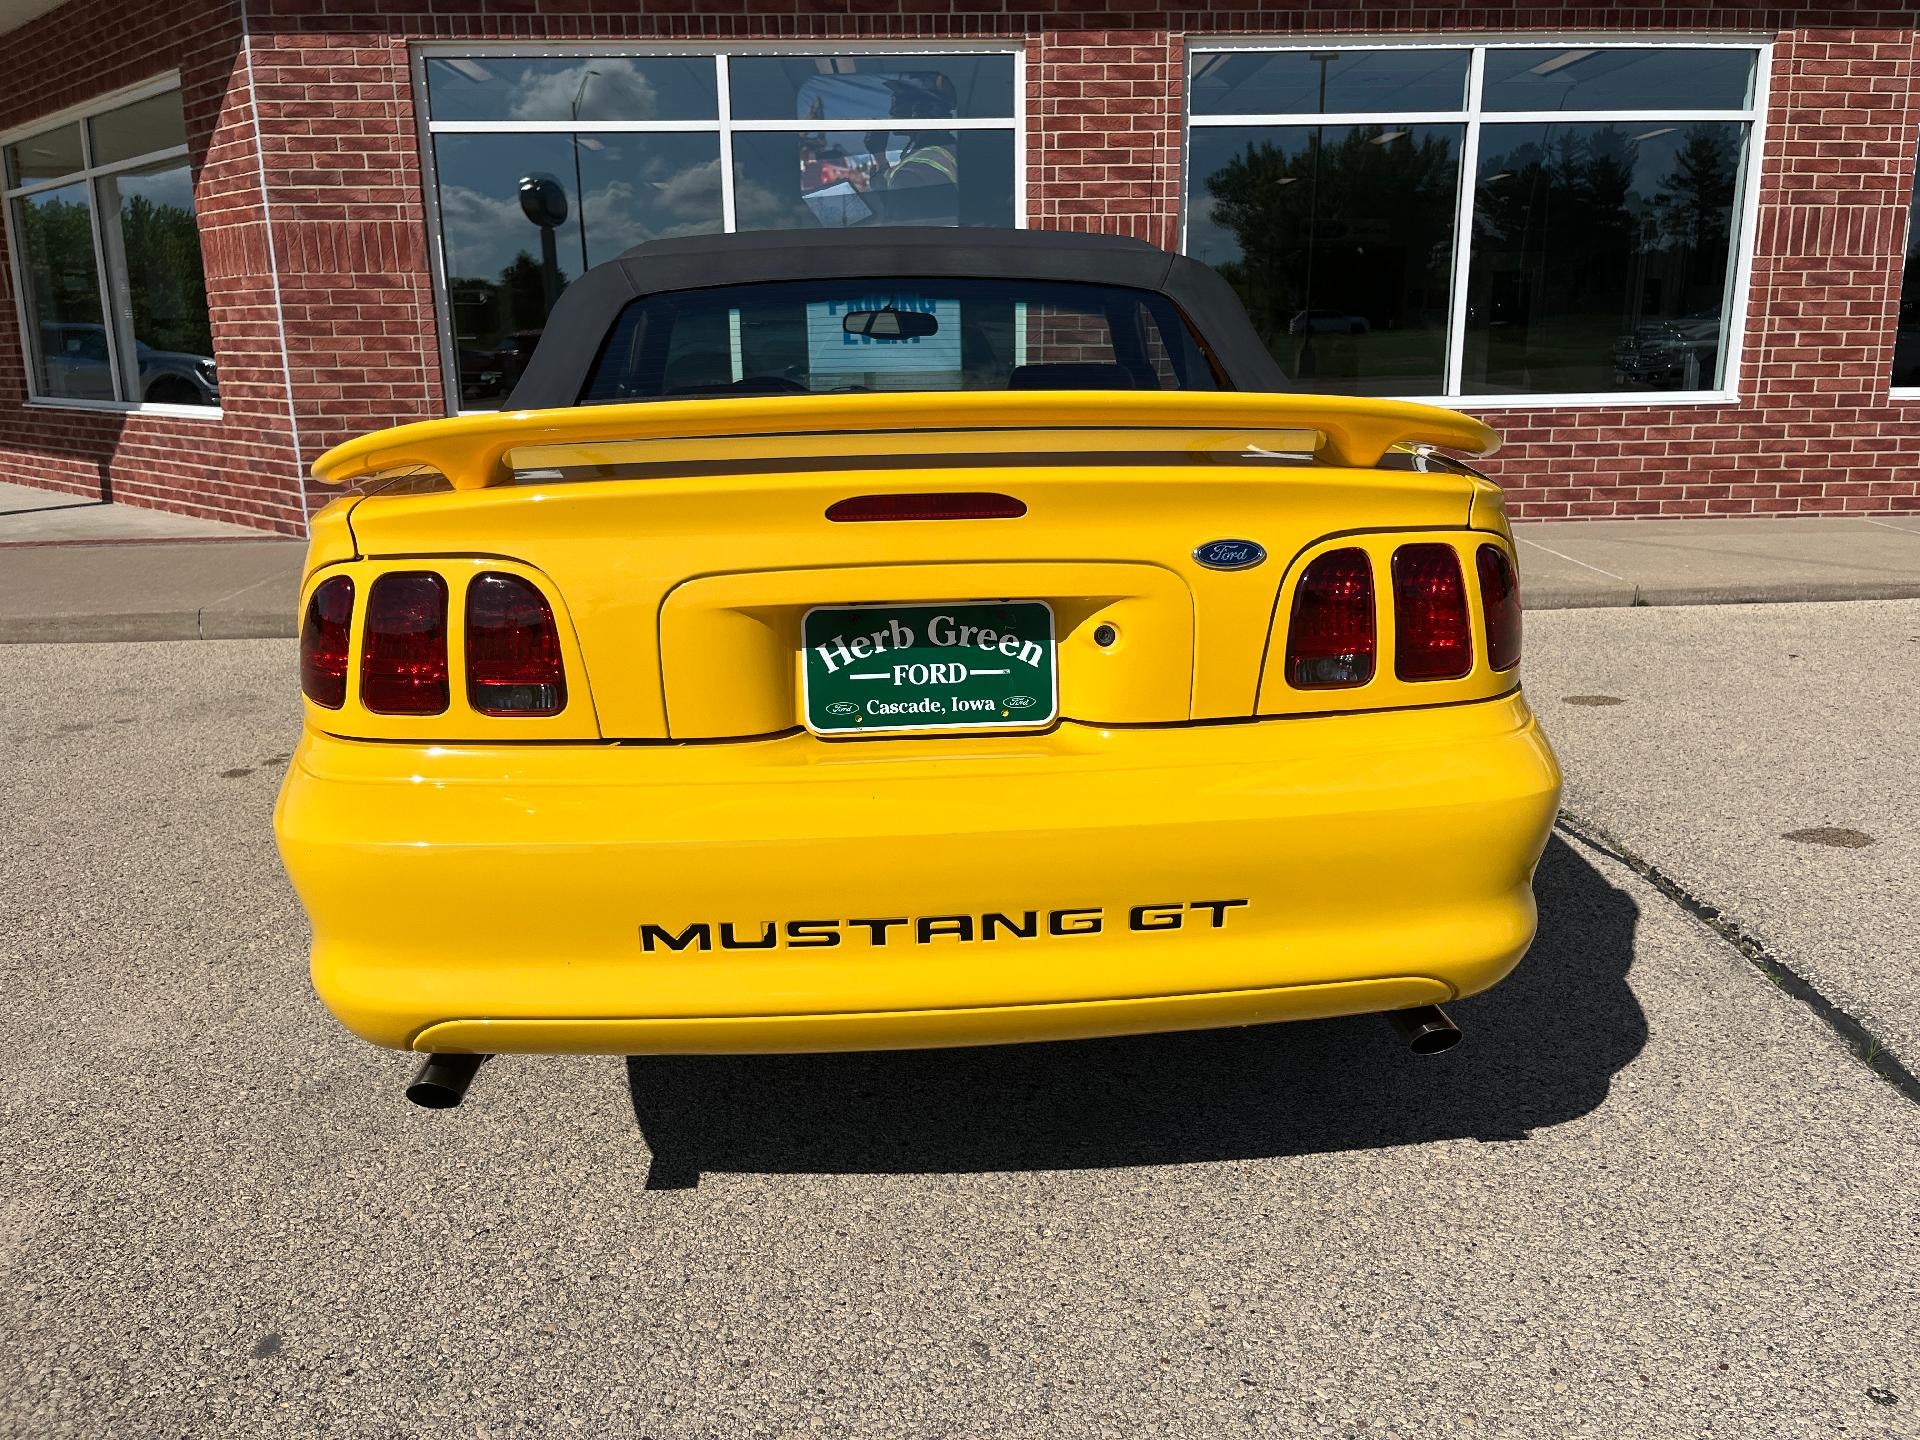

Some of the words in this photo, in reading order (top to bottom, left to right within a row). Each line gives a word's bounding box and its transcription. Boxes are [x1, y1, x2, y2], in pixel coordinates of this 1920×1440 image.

[1209, 544, 1248, 561] Ford
[815, 619, 915, 674] Herb
[927, 615, 1044, 668] Green
[892, 663, 968, 686] FORD
[866, 697, 946, 715] Cascade,
[951, 696, 996, 711] Iowa
[640, 907, 1103, 952] MUSTANG
[1129, 899, 1249, 931] GT
